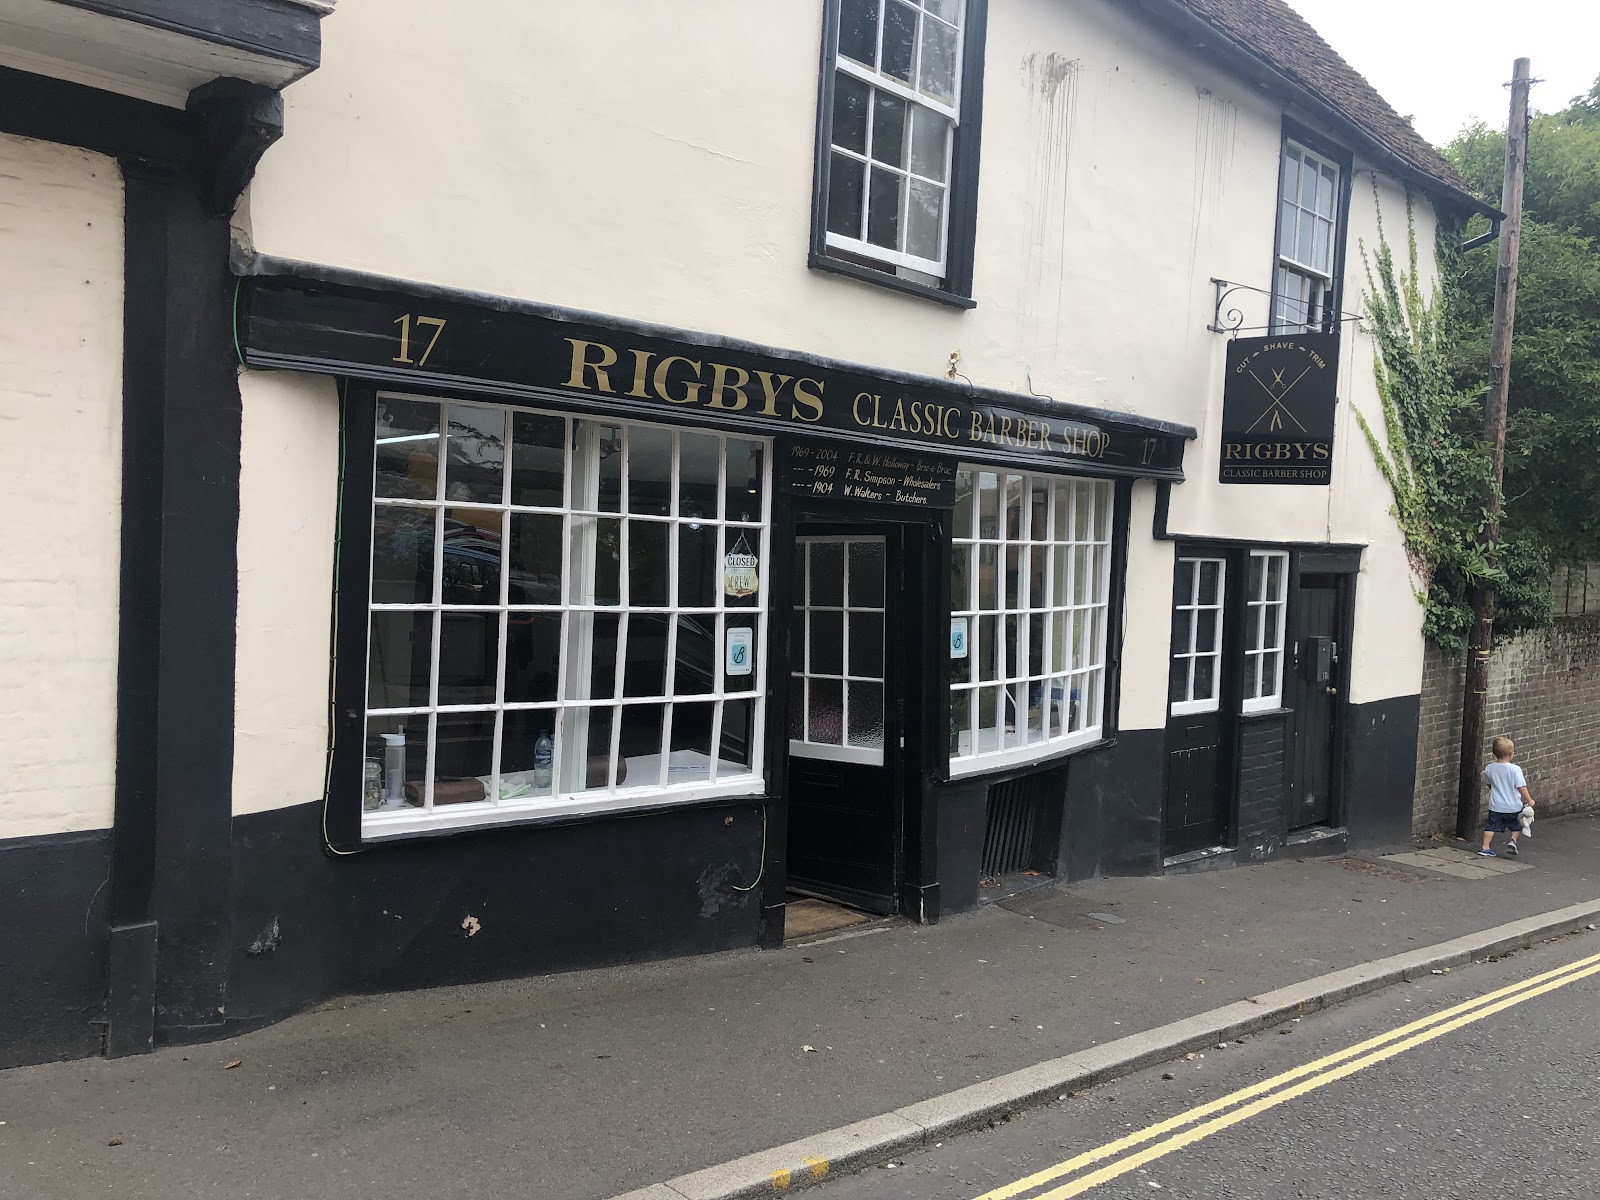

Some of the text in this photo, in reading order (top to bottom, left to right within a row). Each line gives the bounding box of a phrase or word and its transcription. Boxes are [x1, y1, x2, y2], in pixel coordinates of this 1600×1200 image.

[392, 313, 446, 367] 17
[1263, 342, 1295, 352] SHAVE
[1236, 357, 1250, 373] CUT
[1308, 350, 1326, 369] TRIM
[561, 338, 1111, 458] RIGBYS CLASSIC BARBER SHOP
[1141, 437, 1157, 467] 17
[1224, 443, 1329, 460] RIGBYS
[864, 470, 896, 486] Simpson
[1223, 469, 1327, 479] CLASSIC BARBER SHOP
[728, 556, 755, 567] CLOSED
[730, 575, 751, 588] CREW
